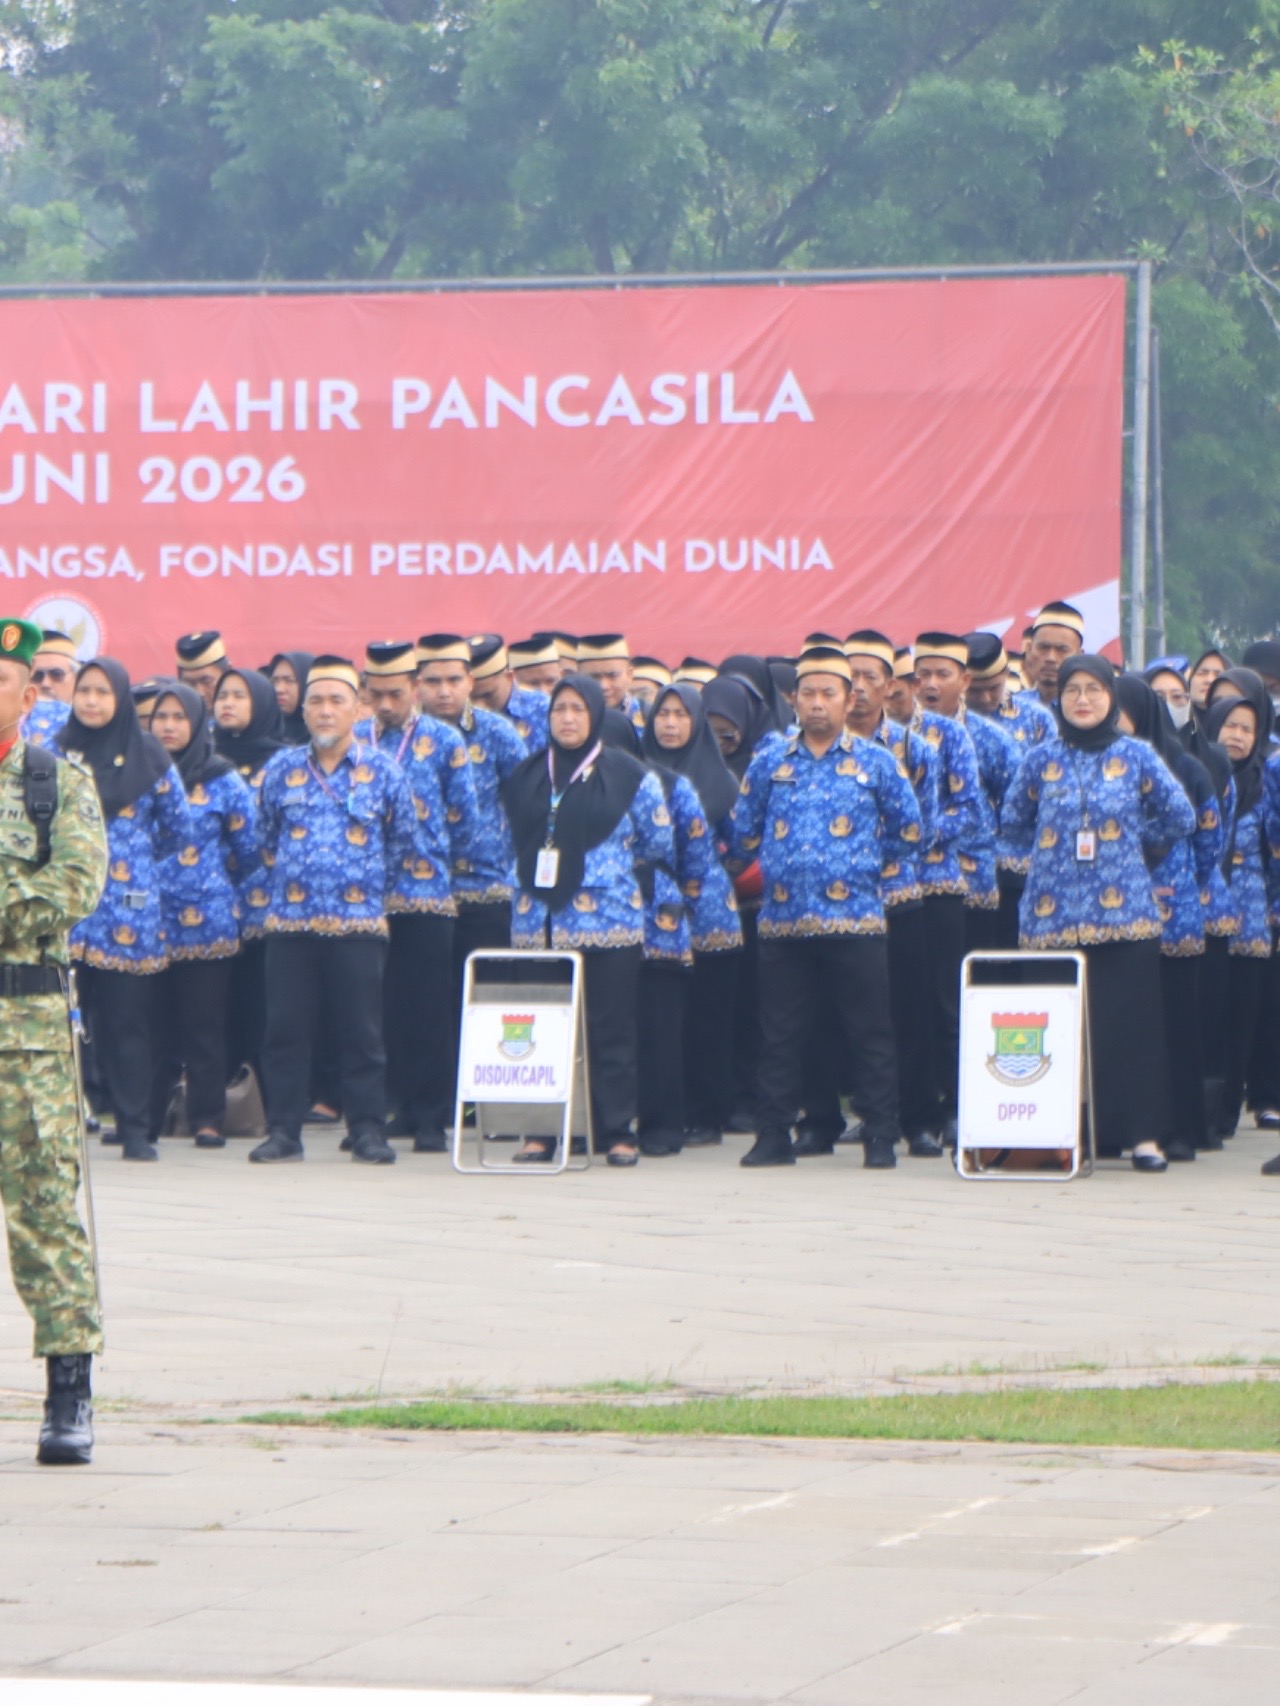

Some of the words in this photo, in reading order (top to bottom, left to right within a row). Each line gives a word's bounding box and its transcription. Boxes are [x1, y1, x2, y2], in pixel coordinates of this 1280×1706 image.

[140, 378, 361, 432] LAHIR
[392, 369, 815, 429] PANCASILA
[139, 455, 306, 503] 2026
[160, 543, 353, 577] FONDASI
[371, 539, 666, 576] PERDAMAIAN
[684, 538, 833, 572] DUNIA
[473, 1064, 557, 1088] DISDUKCAPIL
[998, 1103, 1037, 1121] DPPP
